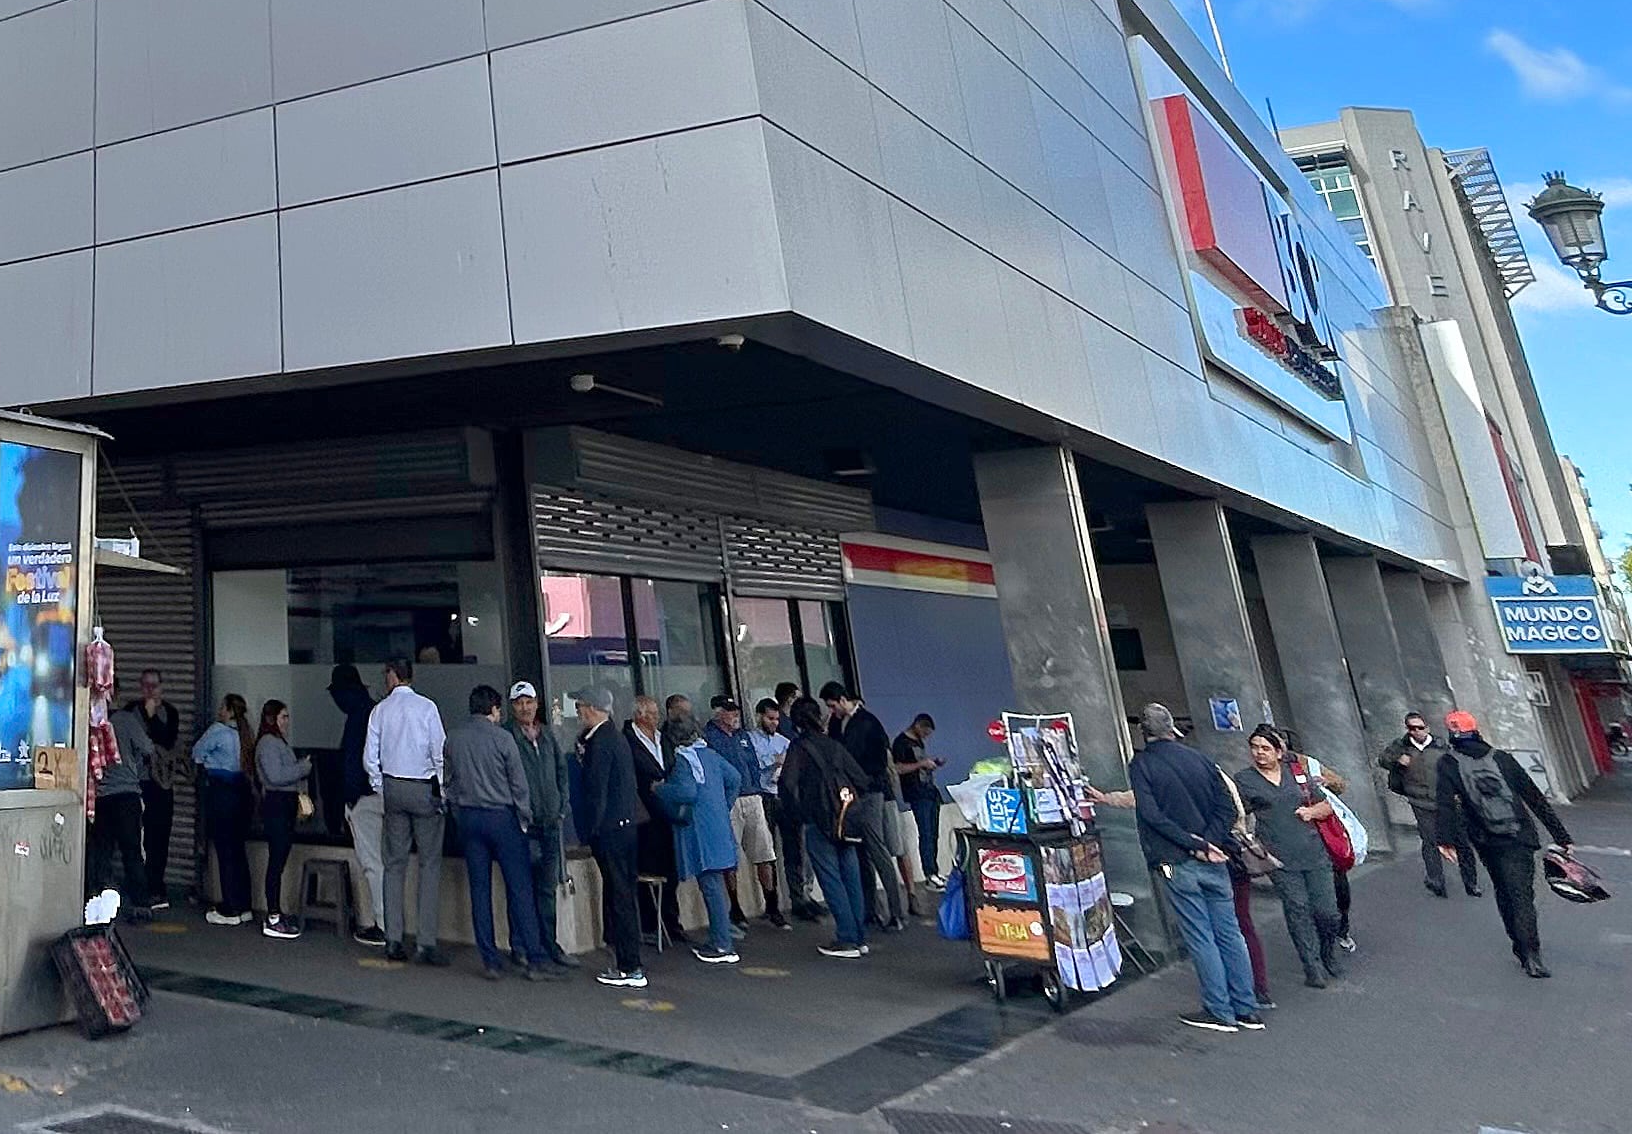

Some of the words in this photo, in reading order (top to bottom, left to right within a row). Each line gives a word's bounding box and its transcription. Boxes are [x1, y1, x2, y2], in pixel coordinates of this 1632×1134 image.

[8, 554, 22, 565] un
[22, 552, 73, 565] verdadero
[6, 565, 71, 592] Festival
[17, 590, 30, 605] de
[31, 590, 41, 604] la
[41, 589, 60, 603] Luz
[1503, 606, 1593, 622] MUNDO
[1505, 622, 1602, 642] MÁGICO
